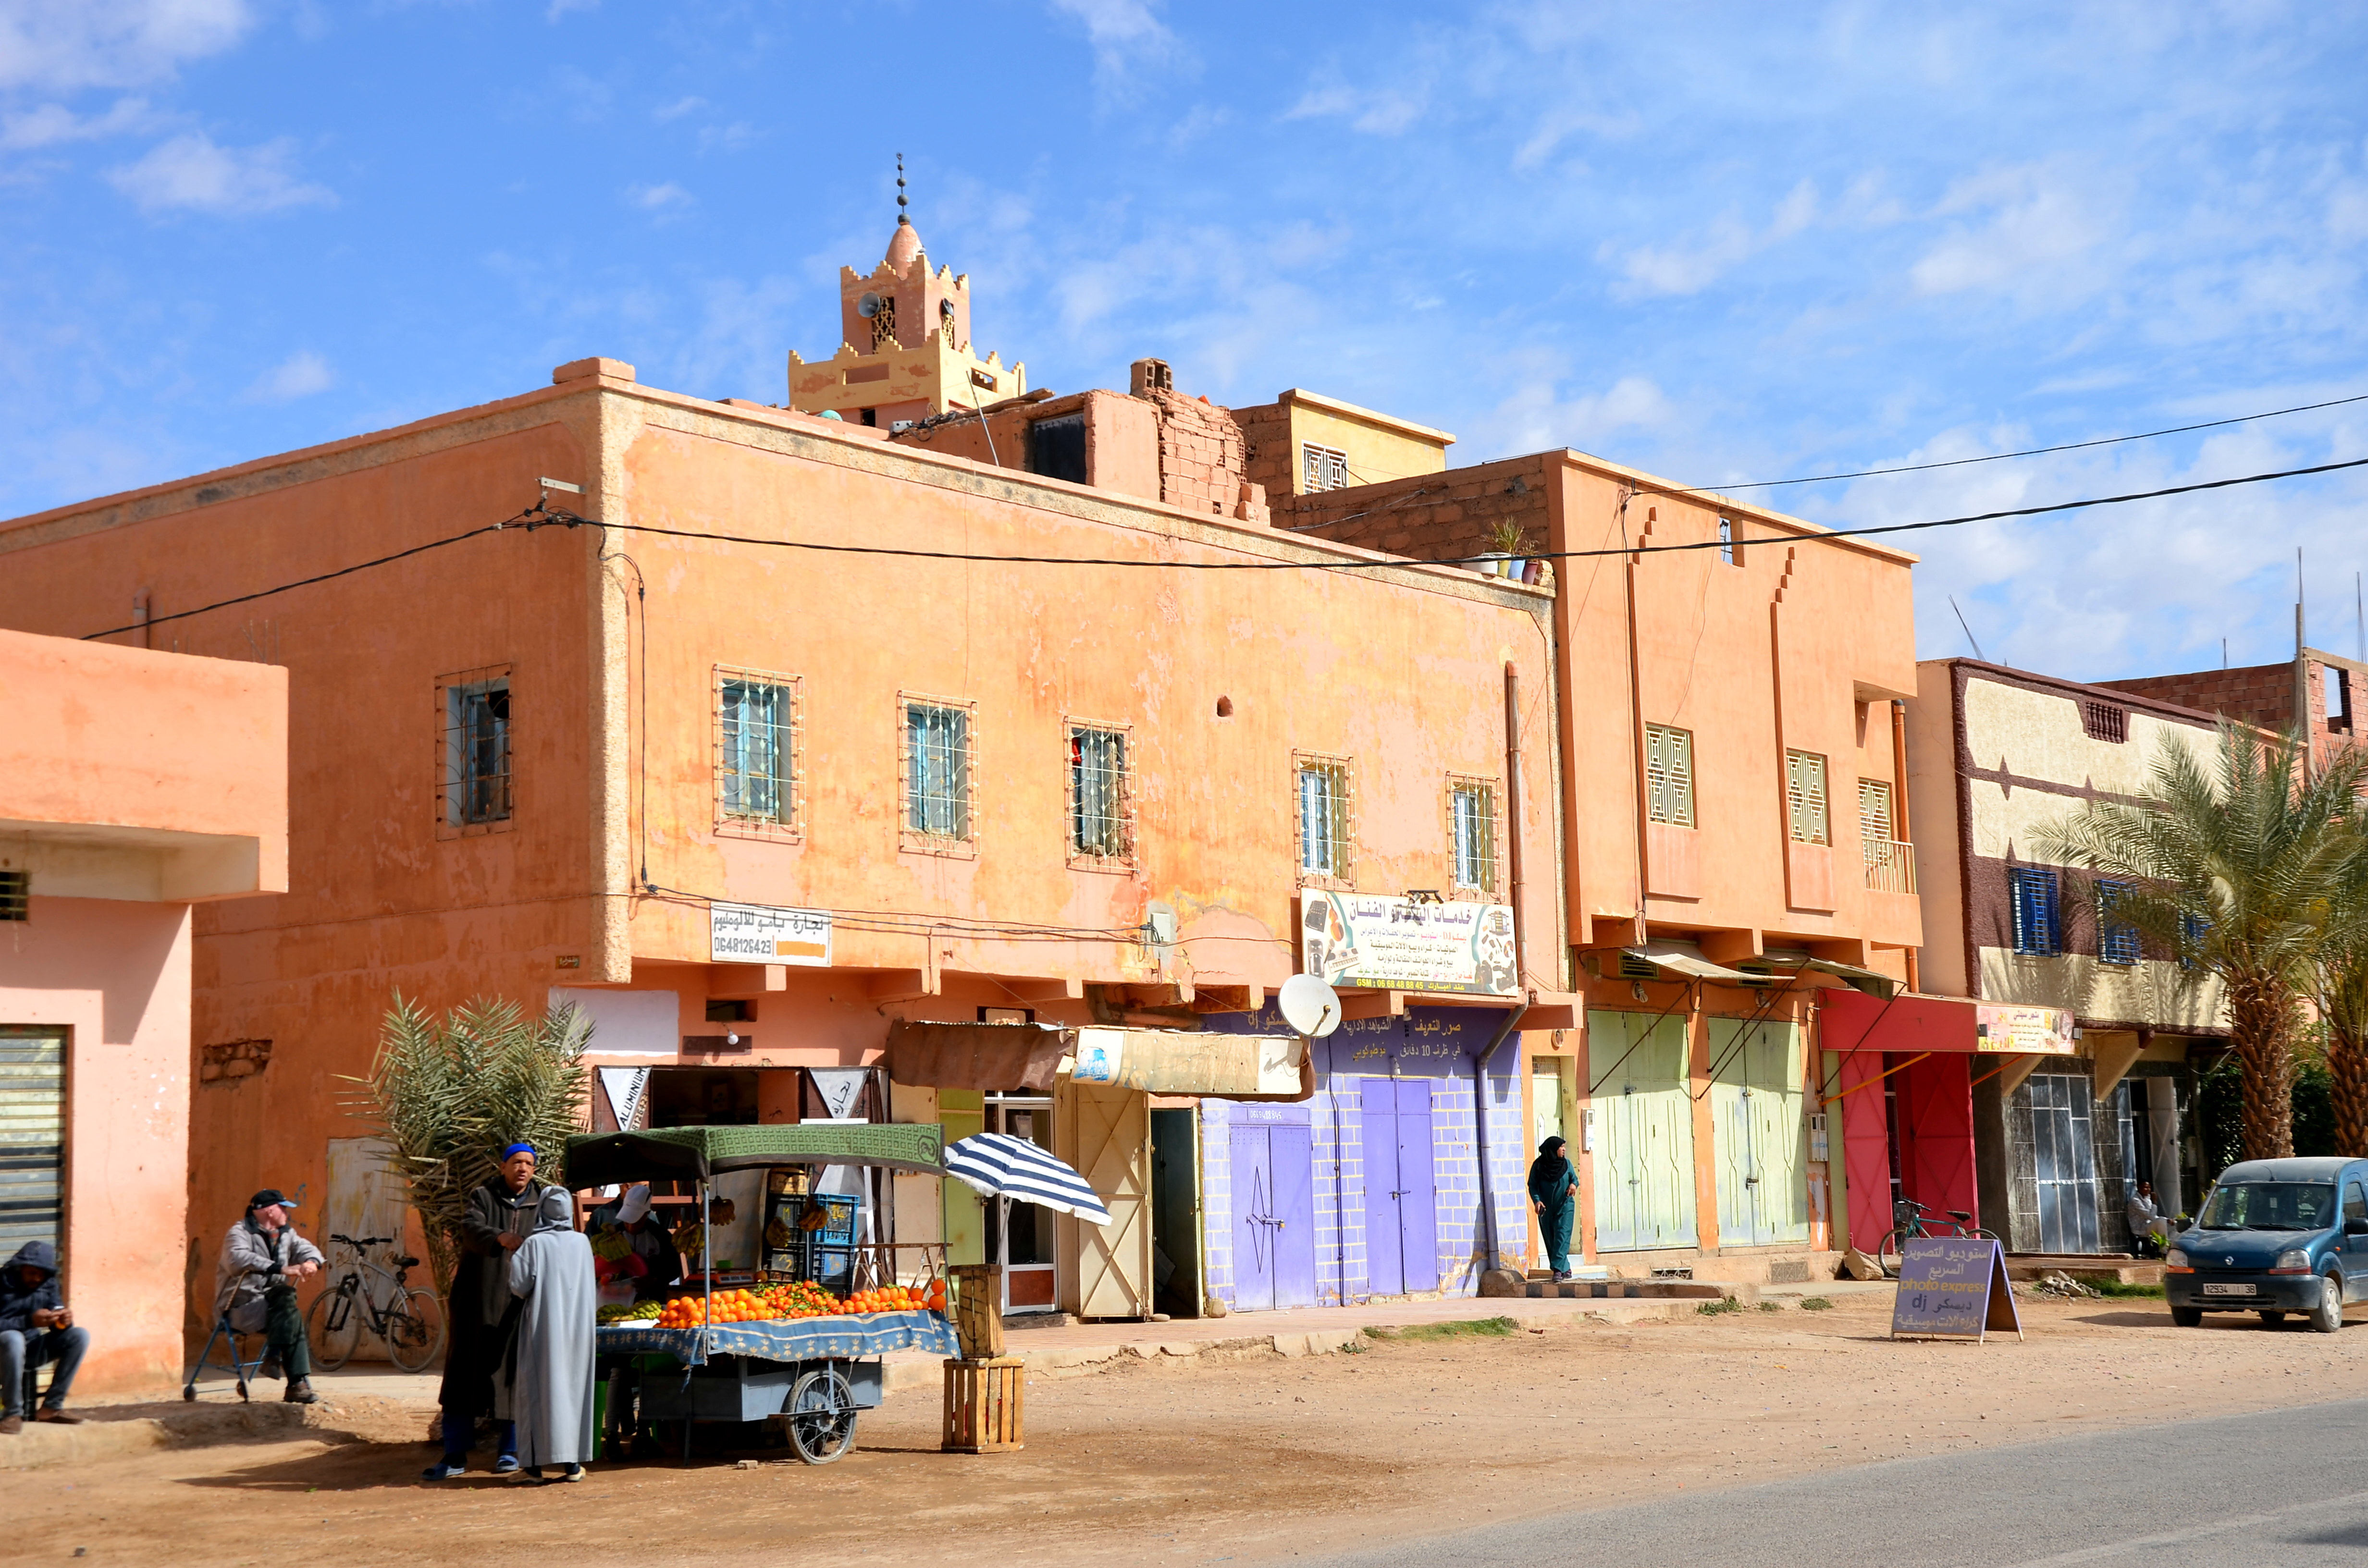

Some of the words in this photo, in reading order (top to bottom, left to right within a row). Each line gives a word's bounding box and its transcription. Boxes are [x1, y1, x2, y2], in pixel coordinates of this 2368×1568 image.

[1350, 901, 1386, 921] الفنان
[1434, 907, 1472, 924] خدمات
[793, 915, 823, 935] نجارة
[714, 937, 771, 954] 0648126423
[1357, 978, 1372, 987] GSM
[1377, 980, 1385, 988] 06
[1387, 980, 1395, 988] 68
[1396, 980, 1405, 989] 48
[1406, 981, 1414, 989] 88
[1415, 981, 1424, 990] 45
[1415, 1018, 1441, 1036] التعريف
[1442, 1022, 1461, 1036] صور
[1422, 1045, 1431, 1056] 10
[1452, 1042, 1461, 1060] في
[619, 1066, 646, 1127] ALUMINIUM
[1904, 1245, 1944, 1261] التصوير
[1945, 1248, 1992, 1262] استوديو
[1928, 1263, 1964, 1281] السريع
[1900, 1278, 1939, 1293] photo
[1941, 1282, 1986, 1294] express
[2245, 1285, 2255, 1294] 38
[1912, 1293, 1927, 1312] dj
[1933, 1298, 1972, 1313] ديسكو
[1897, 1313, 1936, 1329] موسيقية
